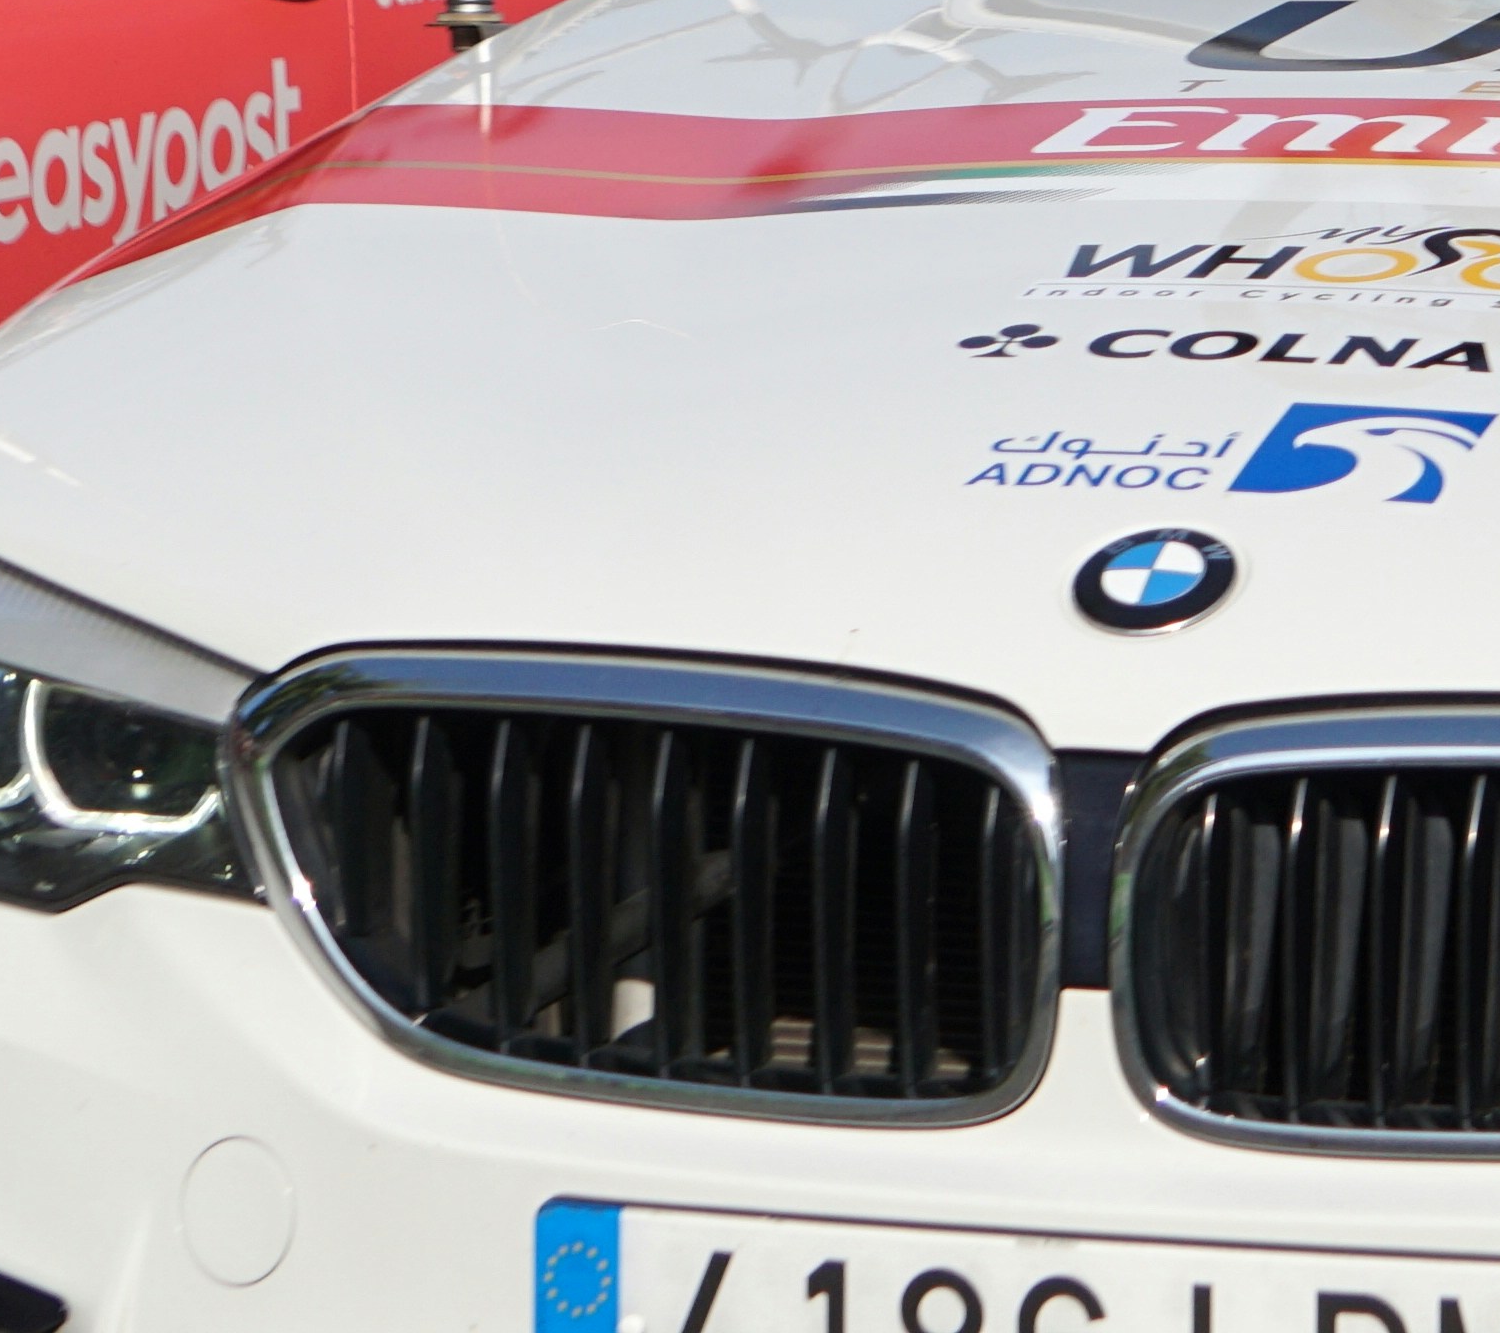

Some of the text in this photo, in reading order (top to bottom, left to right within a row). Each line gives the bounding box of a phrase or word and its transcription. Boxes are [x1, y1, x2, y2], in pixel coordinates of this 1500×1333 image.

[1023, 286, 1203, 300] Indoor
[1240, 288, 1450, 309] Cycling
[963, 461, 1213, 492] ADNOC
